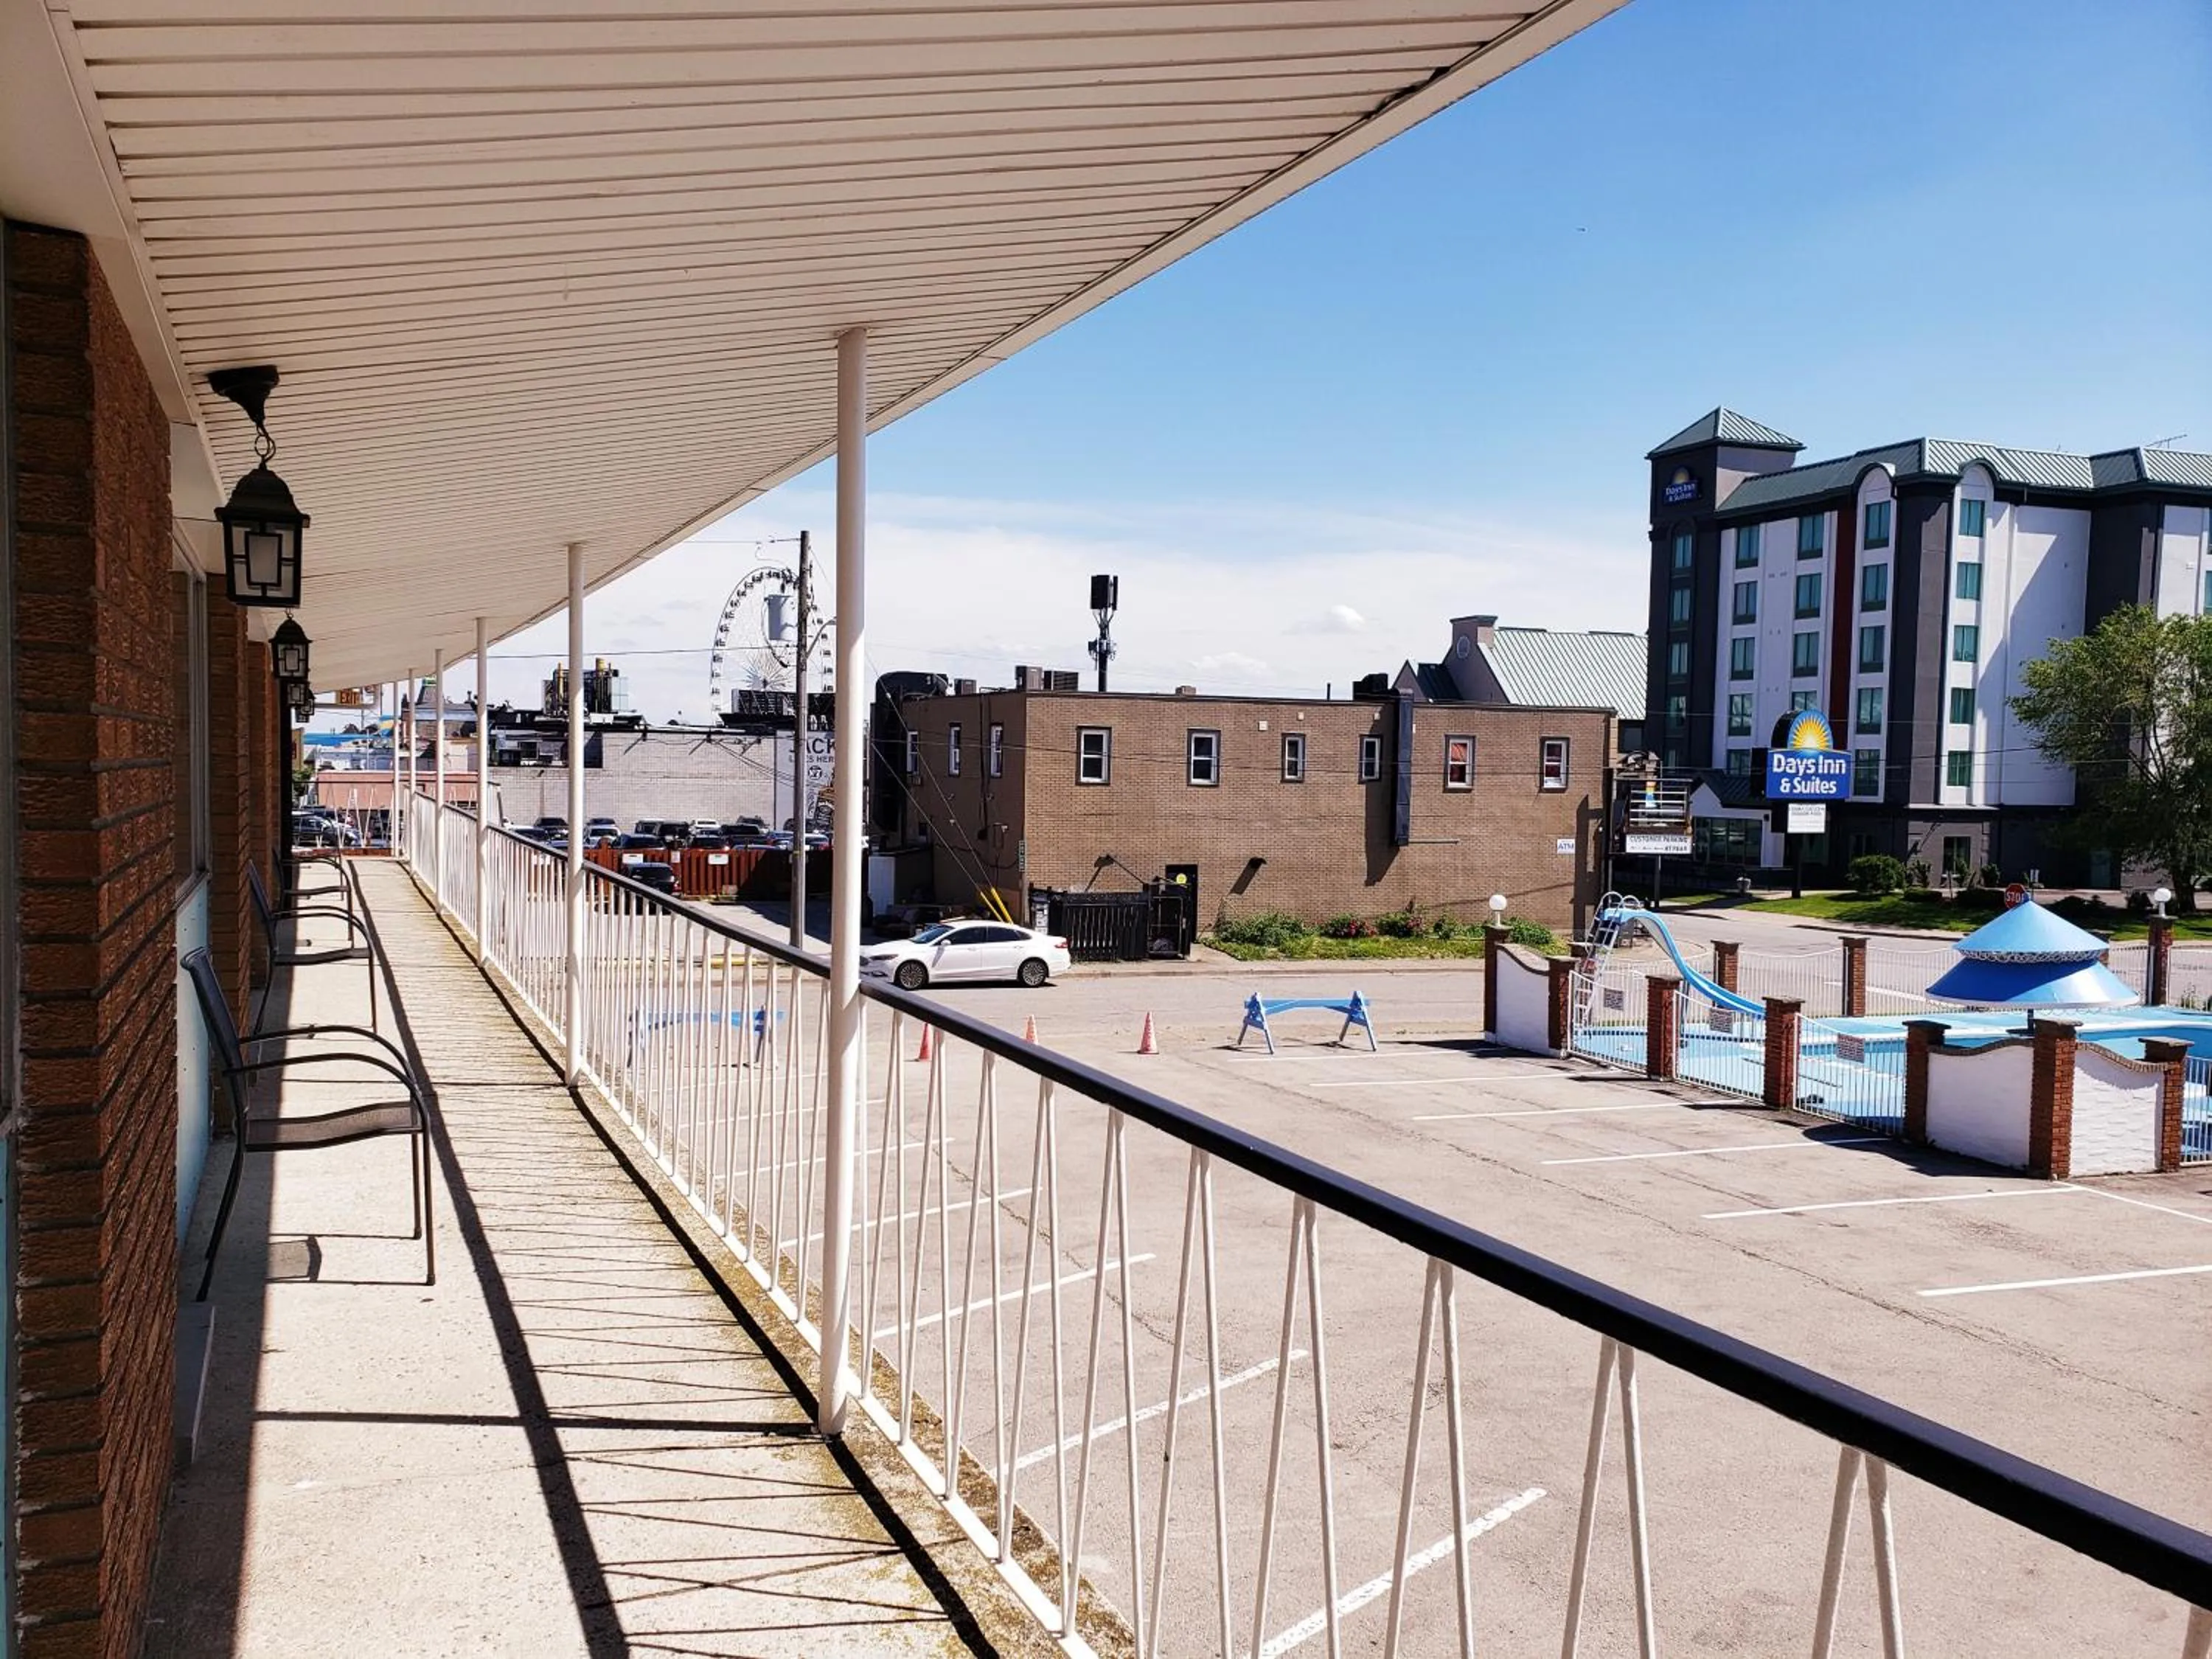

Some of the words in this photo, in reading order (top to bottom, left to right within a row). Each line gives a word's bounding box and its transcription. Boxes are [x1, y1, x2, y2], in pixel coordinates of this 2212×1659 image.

[1773, 753, 1815, 776] Days
[1818, 754, 1846, 774] Inn
[1779, 777, 1791, 793] &
[1792, 776, 1837, 794] Suites
